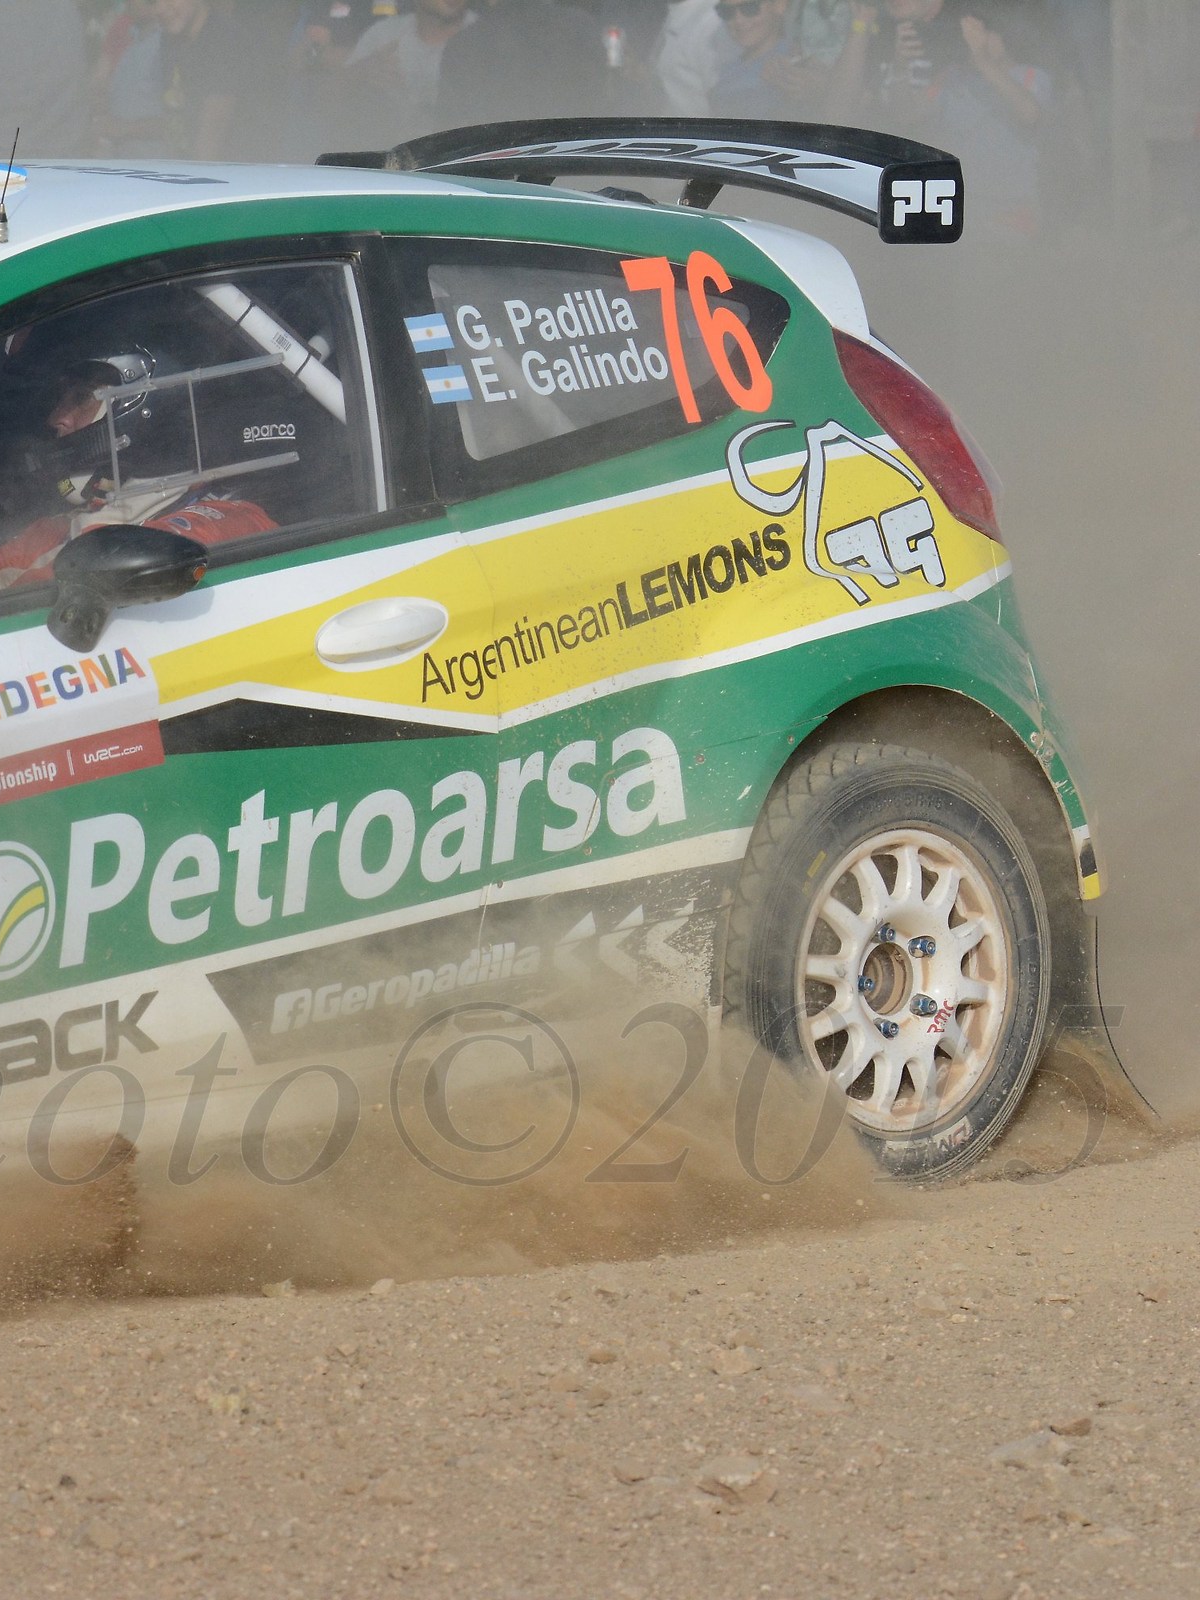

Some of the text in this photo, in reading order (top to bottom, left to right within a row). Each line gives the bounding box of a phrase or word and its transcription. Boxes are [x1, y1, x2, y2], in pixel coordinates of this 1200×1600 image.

[456, 289, 638, 351] G. Padilla
[620, 250, 773, 424] 76
[471, 338, 669, 403] E. Galindo
[243, 422, 296, 442] sparco
[59, 726, 688, 969] Petroarsa
